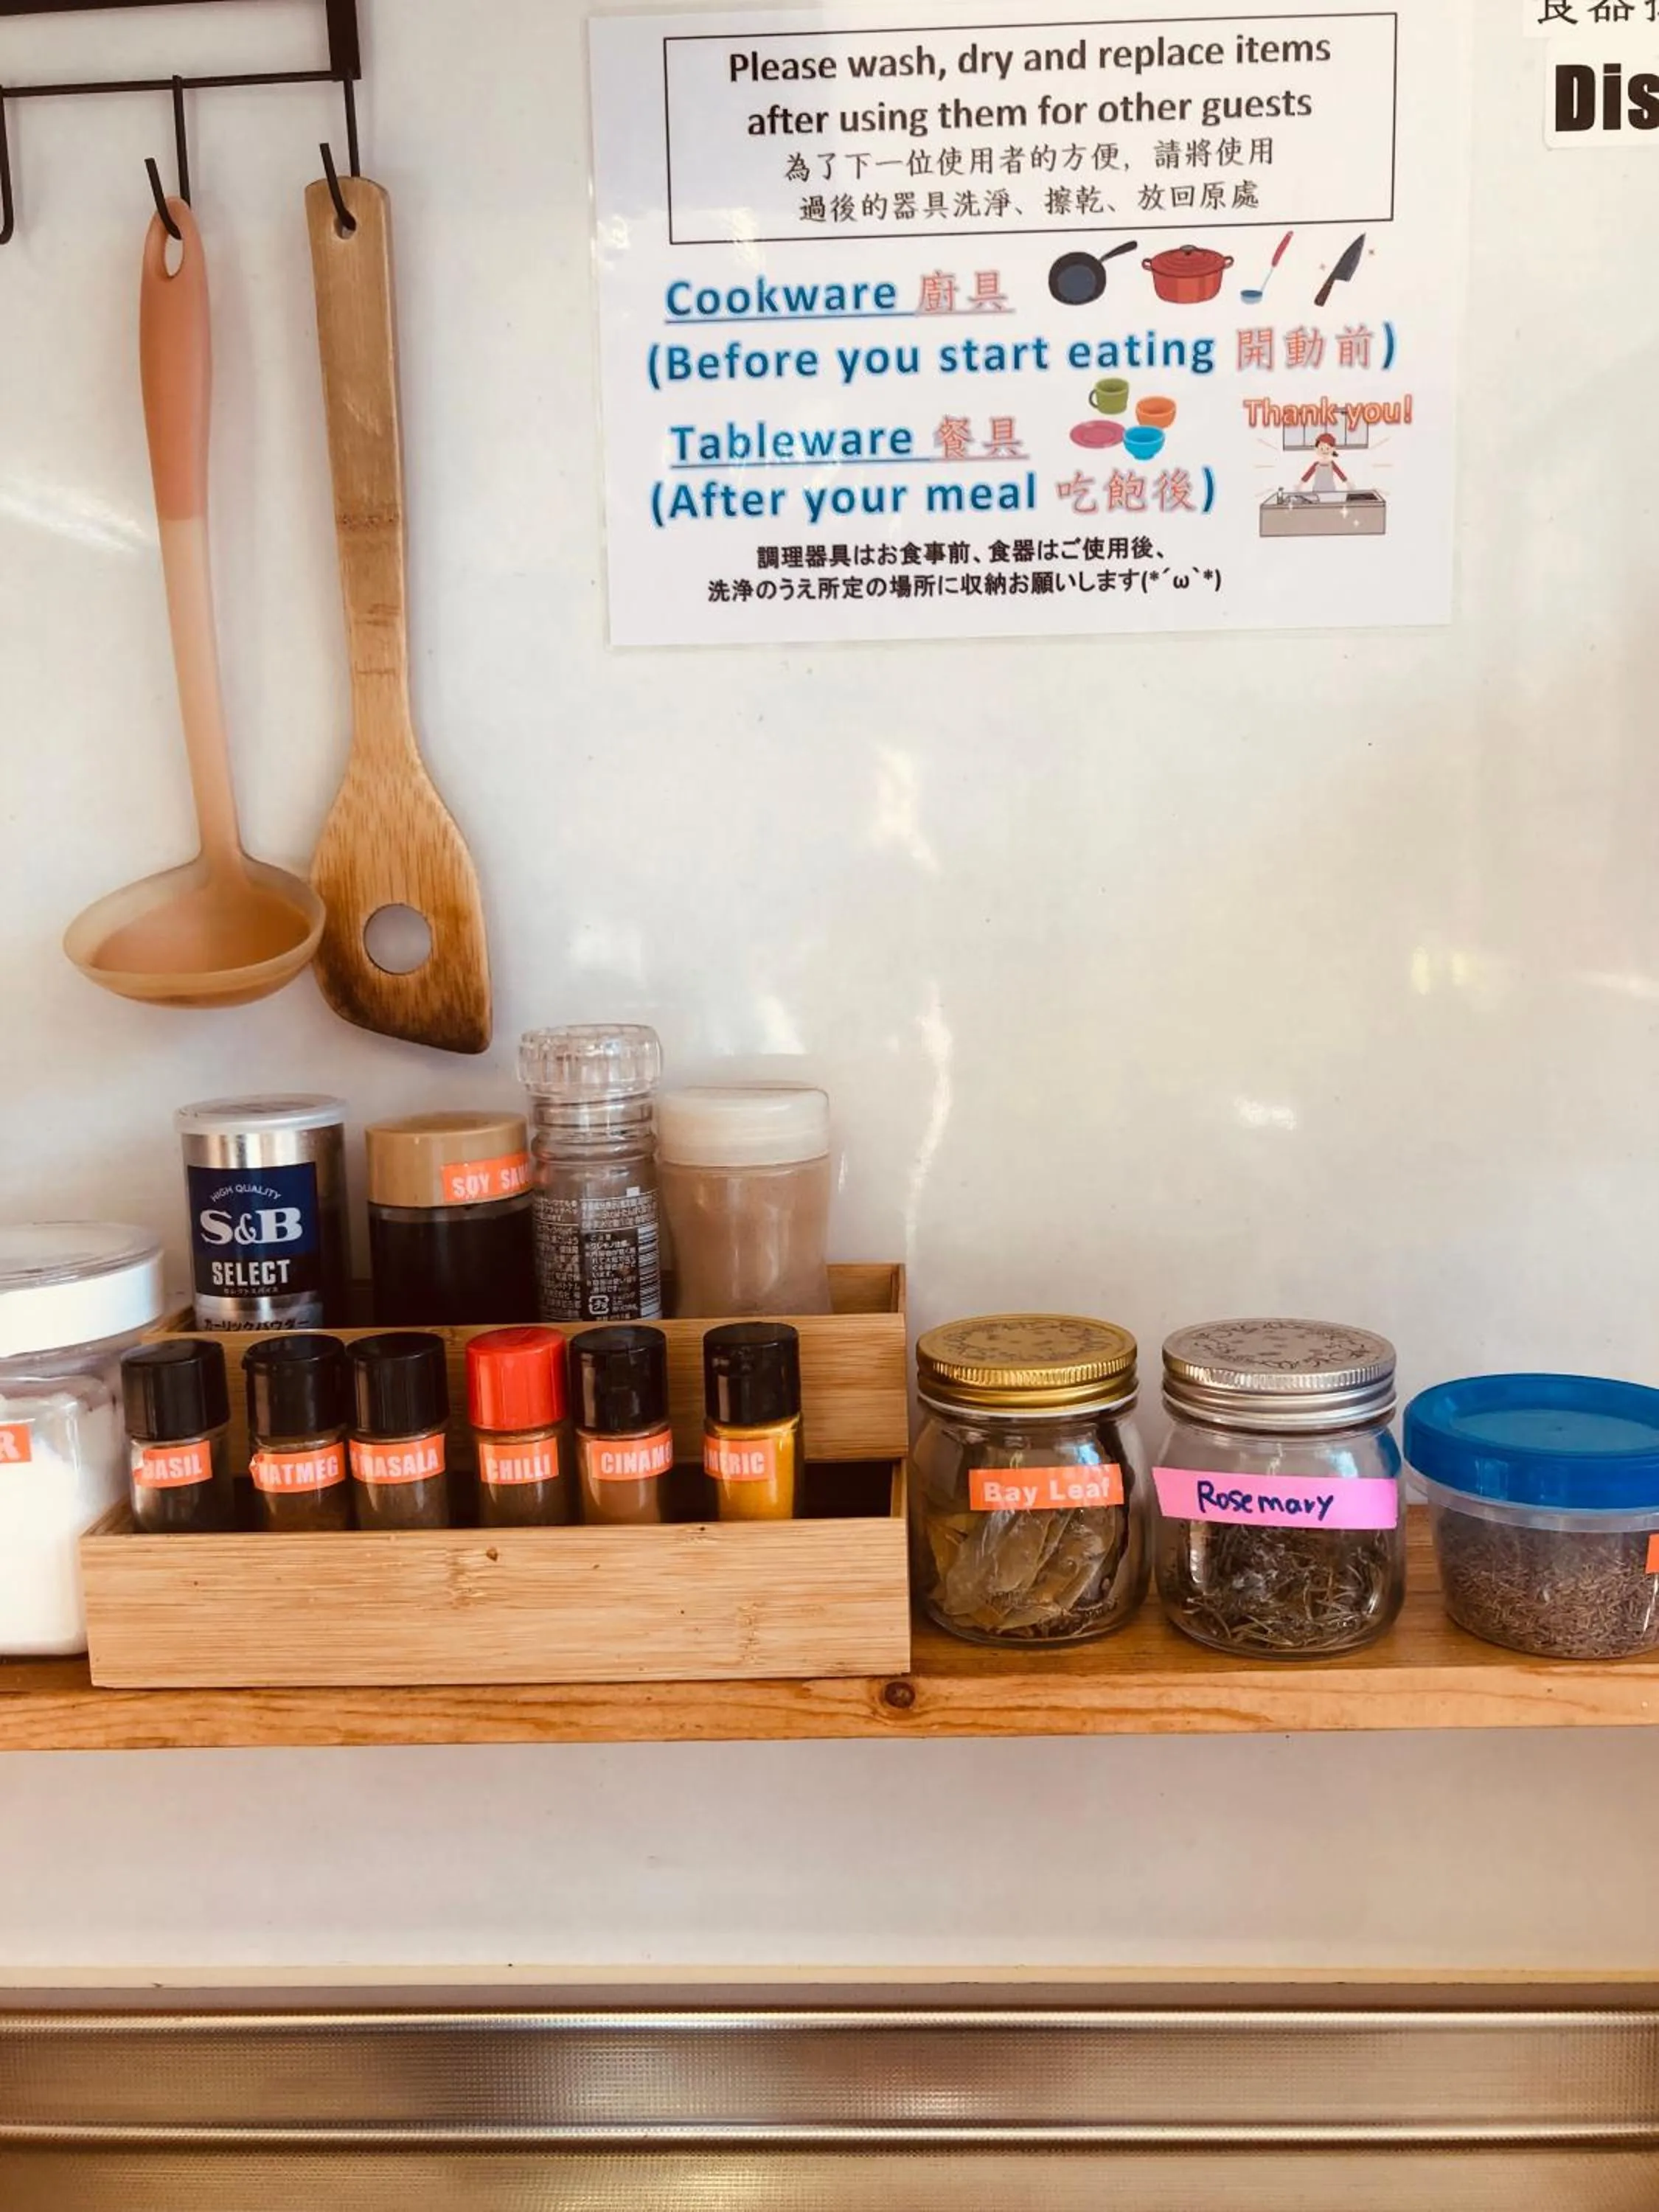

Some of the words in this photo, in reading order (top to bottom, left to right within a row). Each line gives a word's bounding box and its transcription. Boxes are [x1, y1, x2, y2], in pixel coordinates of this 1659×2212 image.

[729, 51, 837, 83] Please
[848, 45, 947, 80] wash,
[959, 43, 1014, 80] dry
[1023, 39, 1087, 72] and
[1099, 36, 1225, 74] replace
[1236, 34, 1332, 64] items
[748, 104, 830, 136] after
[840, 102, 928, 137] using
[938, 98, 1027, 130] them
[1038, 94, 1088, 125] for
[1098, 91, 1192, 123] other
[1201, 89, 1313, 126] guests
[1555, 63, 1659, 132] Dis
[665, 276, 897, 317] Cookware
[918, 270, 1011, 313] 廚具
[647, 340, 819, 391] (Before
[835, 344, 922, 385] you
[938, 334, 1049, 372] start
[1067, 329, 1216, 374] eating
[1242, 394, 1339, 428] Thank
[1344, 393, 1415, 431] you!
[669, 420, 914, 462] Tableware
[933, 414, 1023, 459] 餐具
[650, 480, 787, 528] (After
[802, 483, 908, 525] your
[926, 471, 1037, 512] meal
[235, 1183, 282, 1200] QUALITY
[452, 1174, 490, 1198] SOY
[200, 1208, 302, 1245] S&B
[212, 1259, 290, 1286] SELECT
[486, 1454, 550, 1481] CHILLI
[983, 1481, 1038, 1507] Bay
[1049, 1477, 1110, 1501] Leaf
[1197, 1481, 1334, 1521] Rosemary
